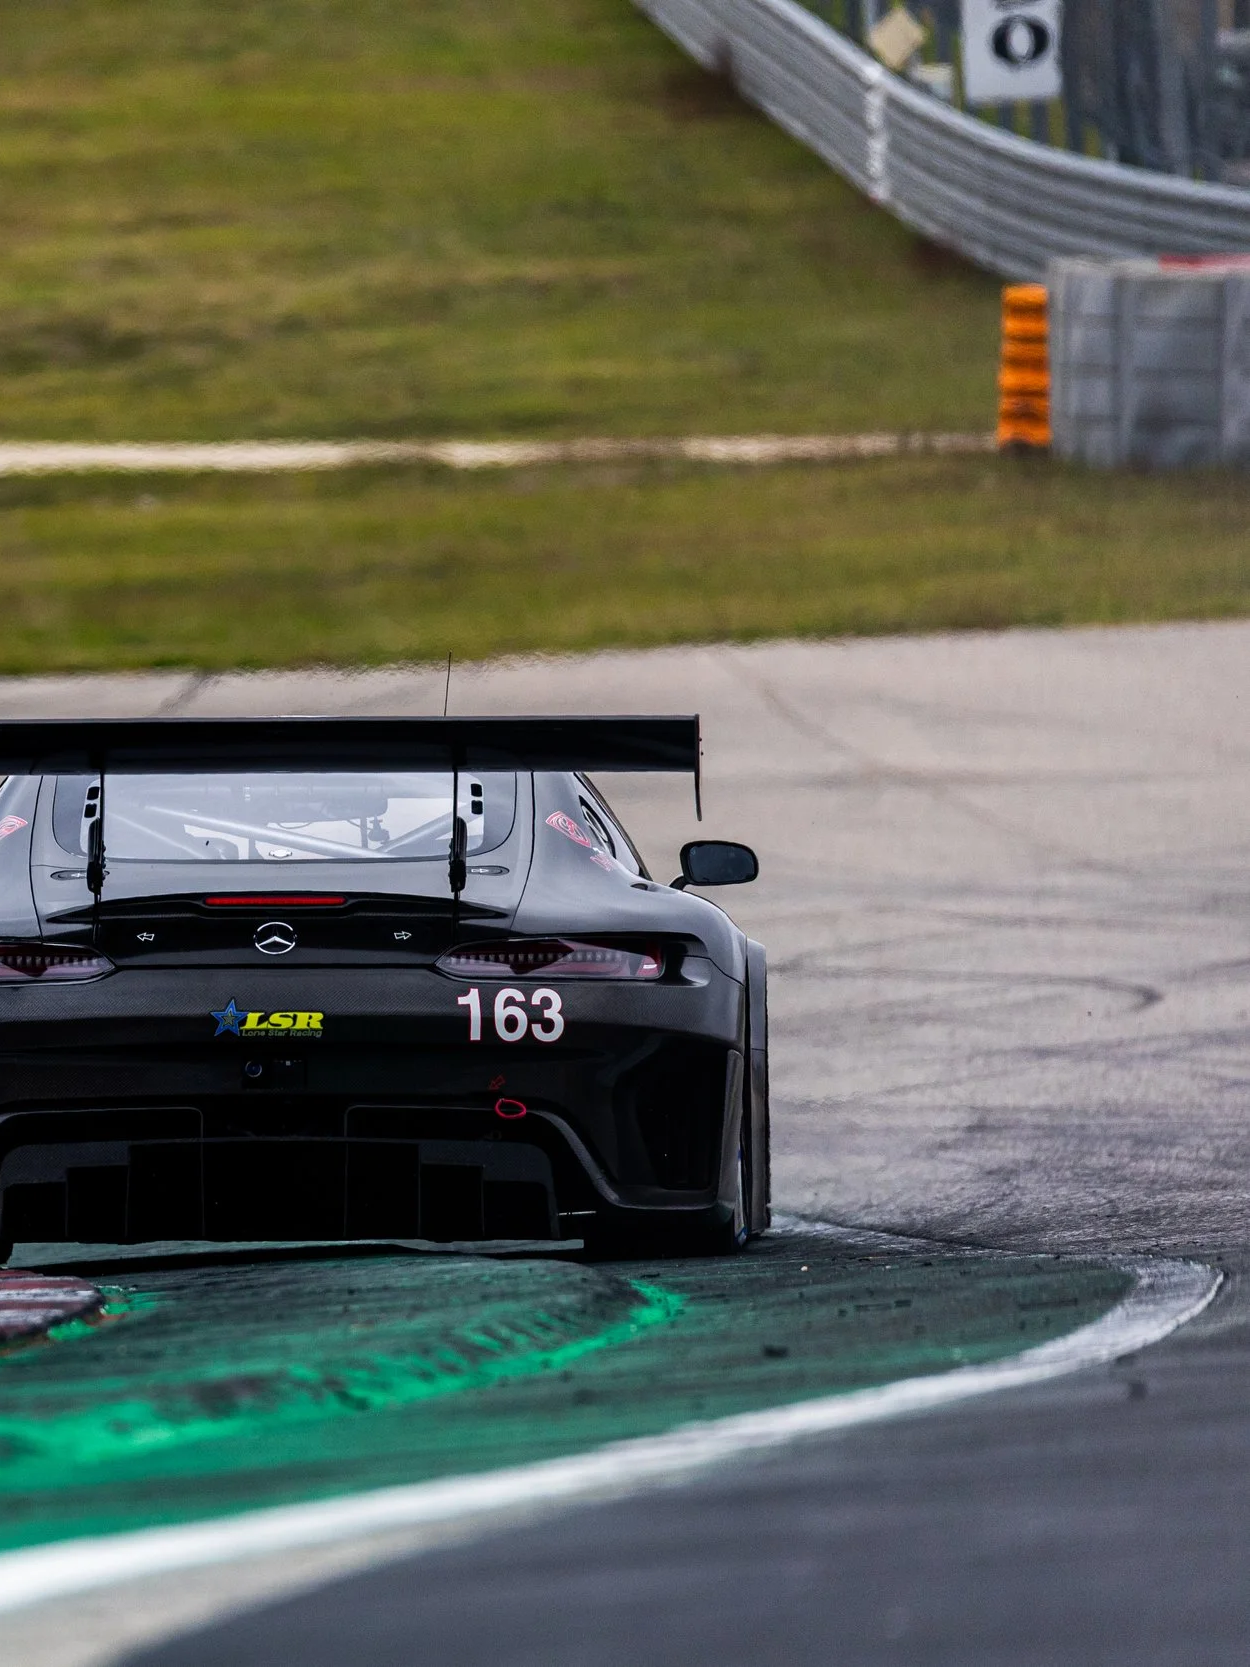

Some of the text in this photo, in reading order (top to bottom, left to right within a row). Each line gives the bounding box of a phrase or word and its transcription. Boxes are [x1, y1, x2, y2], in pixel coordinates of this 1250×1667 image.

[241, 1012, 324, 1029] LSR
[457, 988, 564, 1042] 163
[290, 1030, 322, 1038] Racing
